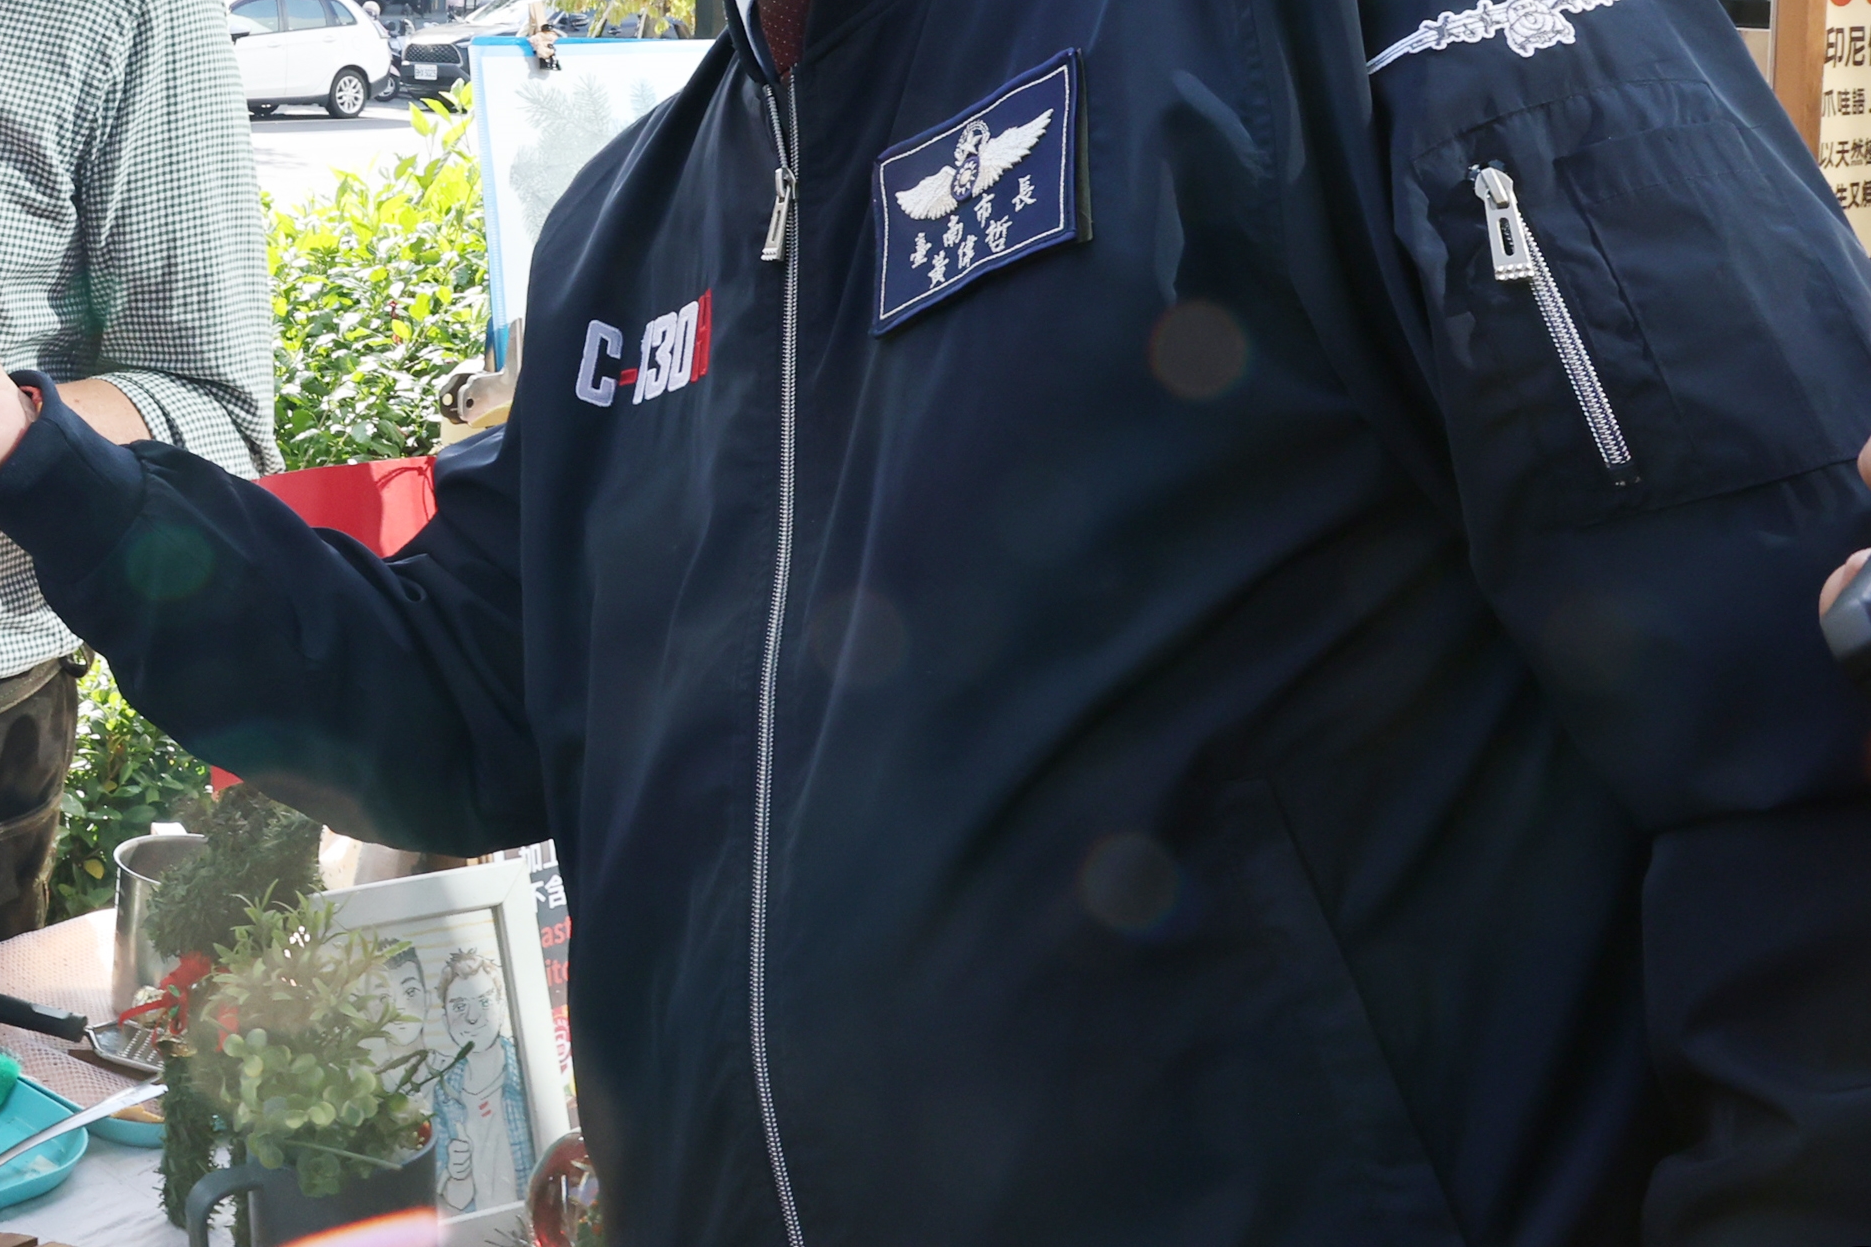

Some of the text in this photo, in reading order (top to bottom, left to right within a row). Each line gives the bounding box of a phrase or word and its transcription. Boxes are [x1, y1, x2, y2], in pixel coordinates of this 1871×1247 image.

[1824, 25, 1871, 69] 印尼
[1822, 88, 1871, 118] 爪哇語
[909, 174, 1037, 269] 臺南市長
[927, 215, 1013, 289] 黃偉哲
[575, 287, 712, 407] C-130H
